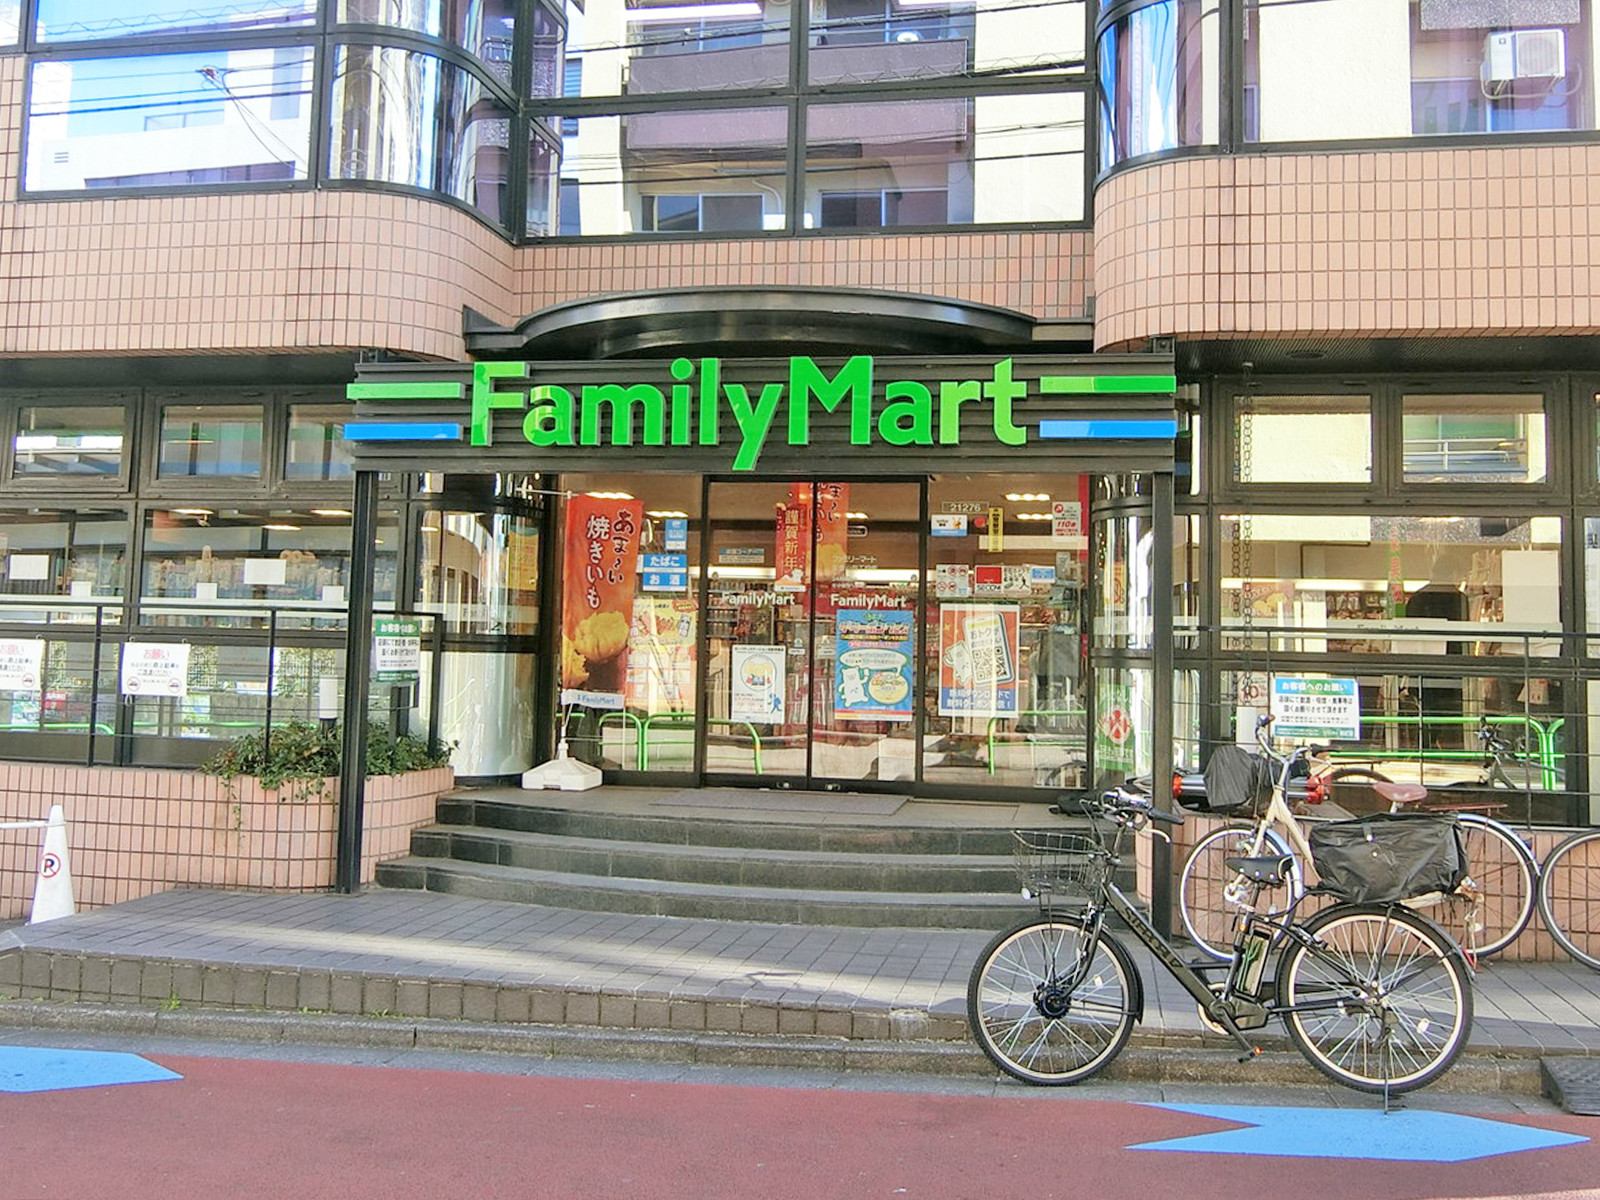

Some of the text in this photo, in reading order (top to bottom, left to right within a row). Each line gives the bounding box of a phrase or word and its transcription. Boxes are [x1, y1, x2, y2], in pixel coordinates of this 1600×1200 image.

[470, 355, 1028, 472] FamilyMart
[950, 503, 981, 513] 21276
[785, 509, 799, 571] 謹賀新年
[586, 514, 612, 609] 焼きいも
[650, 556, 680, 567] たばこ
[722, 591, 796, 608] FamilyMart
[830, 593, 908, 610] FamilyMart
[143, 648, 170, 660] お願い
[1282, 681, 1348, 692] お客様へのお願い
